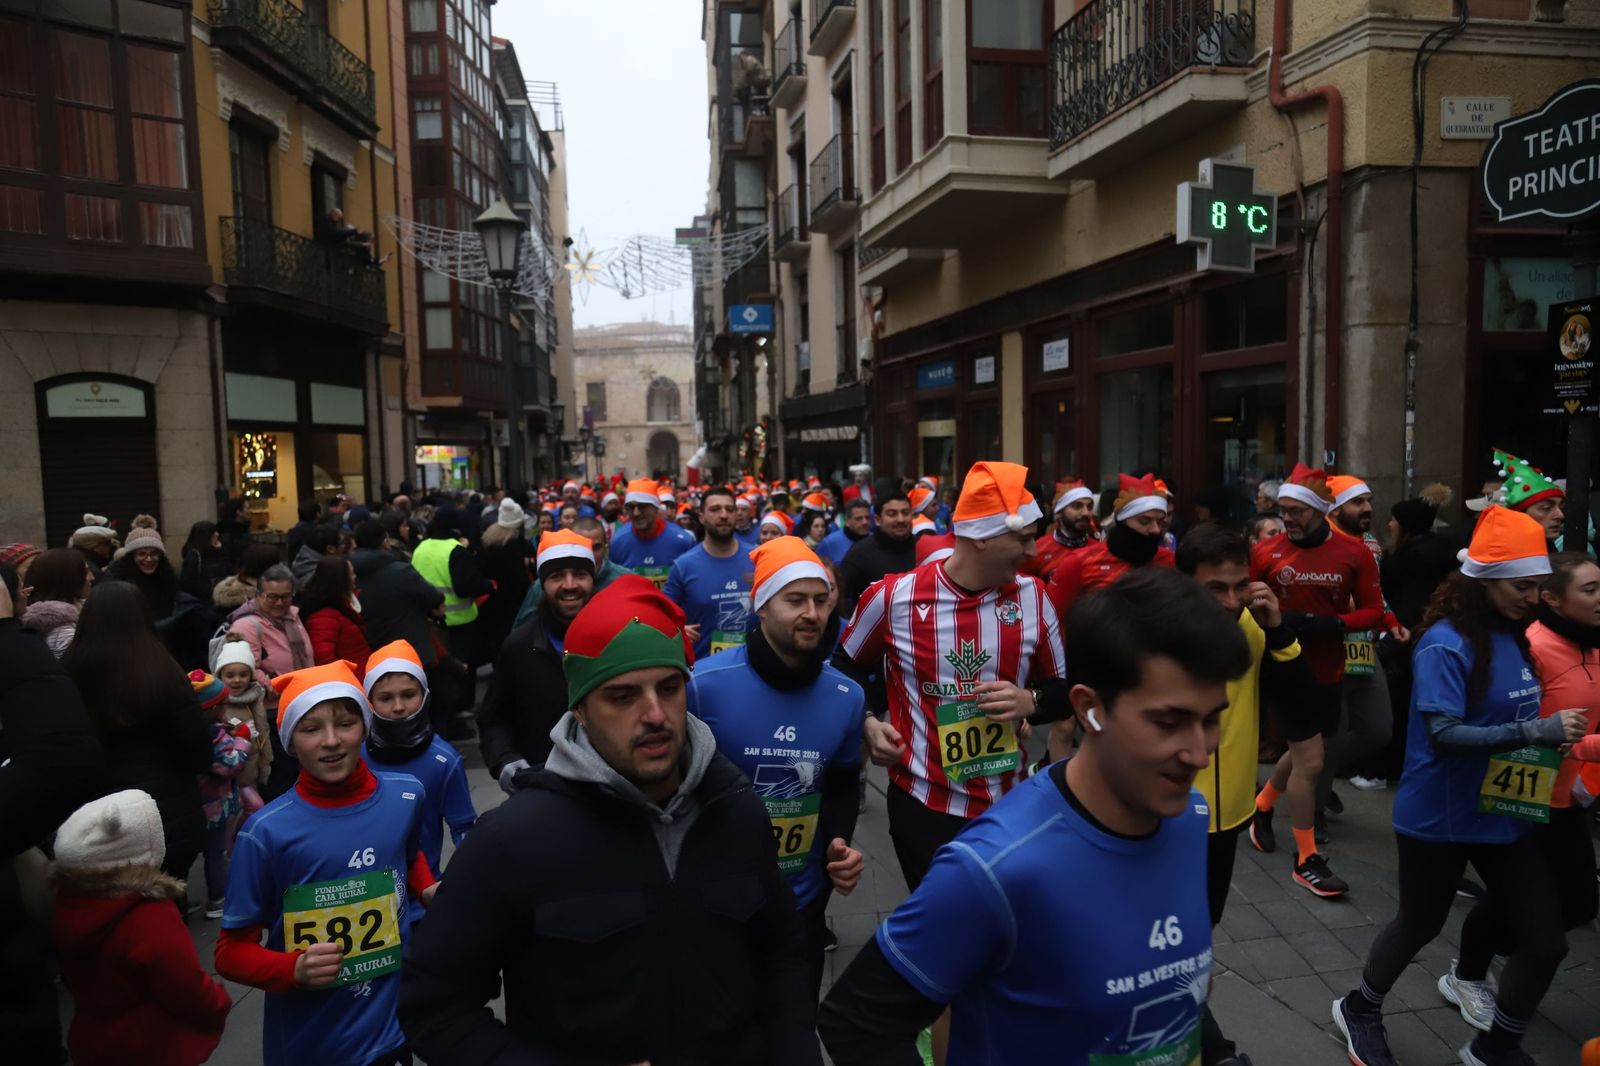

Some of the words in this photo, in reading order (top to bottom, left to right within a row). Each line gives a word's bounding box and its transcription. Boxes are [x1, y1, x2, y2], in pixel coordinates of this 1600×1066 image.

[1466, 103, 1495, 111] CALLE
[1471, 114, 1484, 122] DE
[1508, 155, 1600, 201] PRINCI
[1212, 201, 1227, 229] 8
[1237, 204, 1268, 233] °C
[1528, 271, 1545, 282] Un
[1556, 287, 1572, 300] de
[643, 556, 655, 565] 46
[725, 581, 738, 590] 46
[924, 683, 960, 696] CAJA
[773, 725, 796, 742] 46
[946, 723, 1004, 763] 802
[744, 747, 760, 756] SAN
[762, 748, 800, 758] SILVESTRE
[802, 750, 820, 759] 2025
[963, 764, 982, 775] CAJA
[983, 758, 1014, 770] RURAL
[1492, 765, 1539, 798] 411
[348, 847, 375, 869] 46
[315, 893, 337, 903] CAJA
[339, 887, 367, 900] RURAL
[293, 909, 385, 956] 582
[1148, 915, 1183, 950] 46
[354, 955, 396, 974] RURAL
[1105, 976, 1135, 995] SAN
[1137, 957, 1196, 989] SILVESTRE
